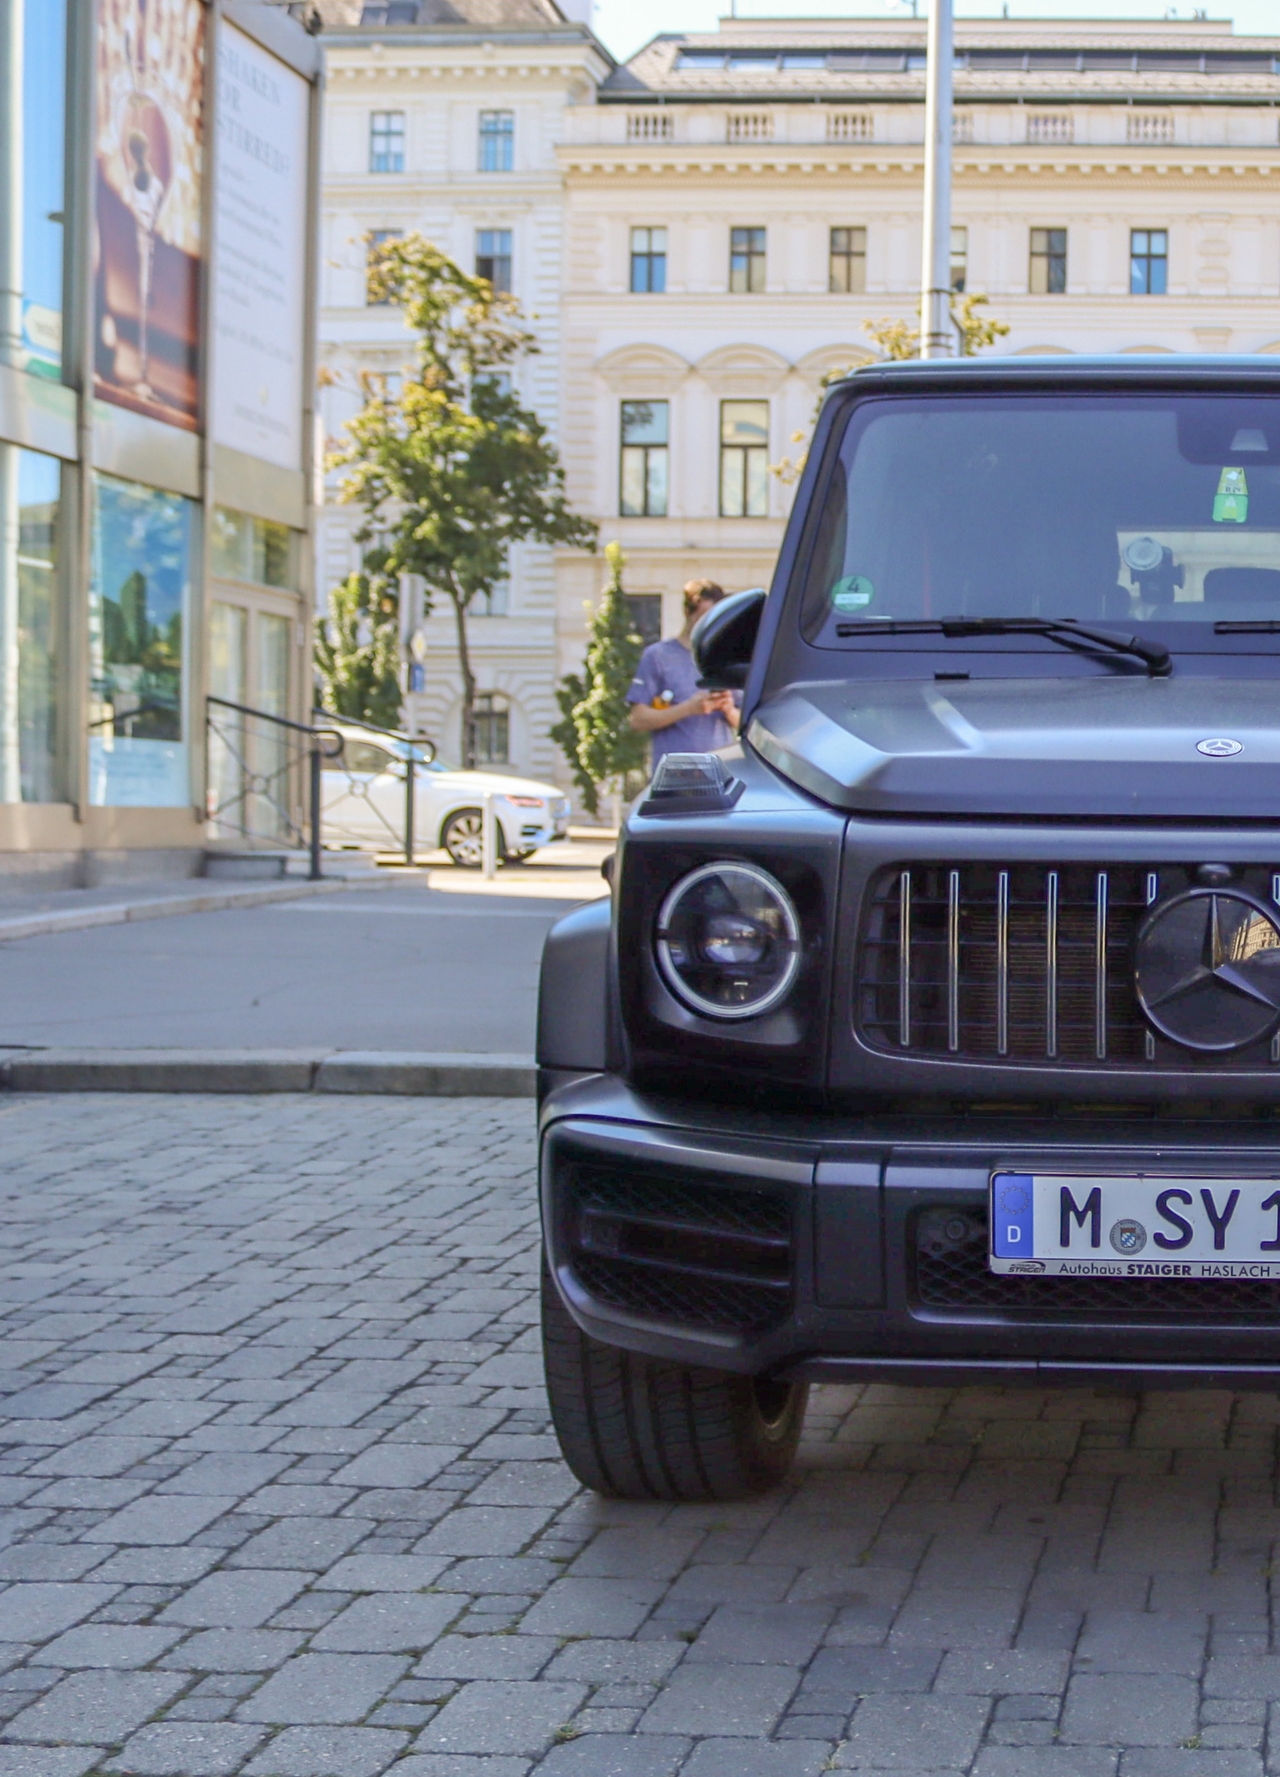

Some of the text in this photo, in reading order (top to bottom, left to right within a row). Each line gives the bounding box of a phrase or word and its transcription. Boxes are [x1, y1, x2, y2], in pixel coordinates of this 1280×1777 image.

[847, 577, 859, 593] 4
[1007, 1225, 1021, 1243] D
[1060, 1186, 1101, 1248] M
[1153, 1188, 1241, 1251] SY
[1059, 1263, 1122, 1275] Autohaus
[1127, 1264, 1192, 1276] STAIGER
[1201, 1265, 1270, 1277] HASLACH
